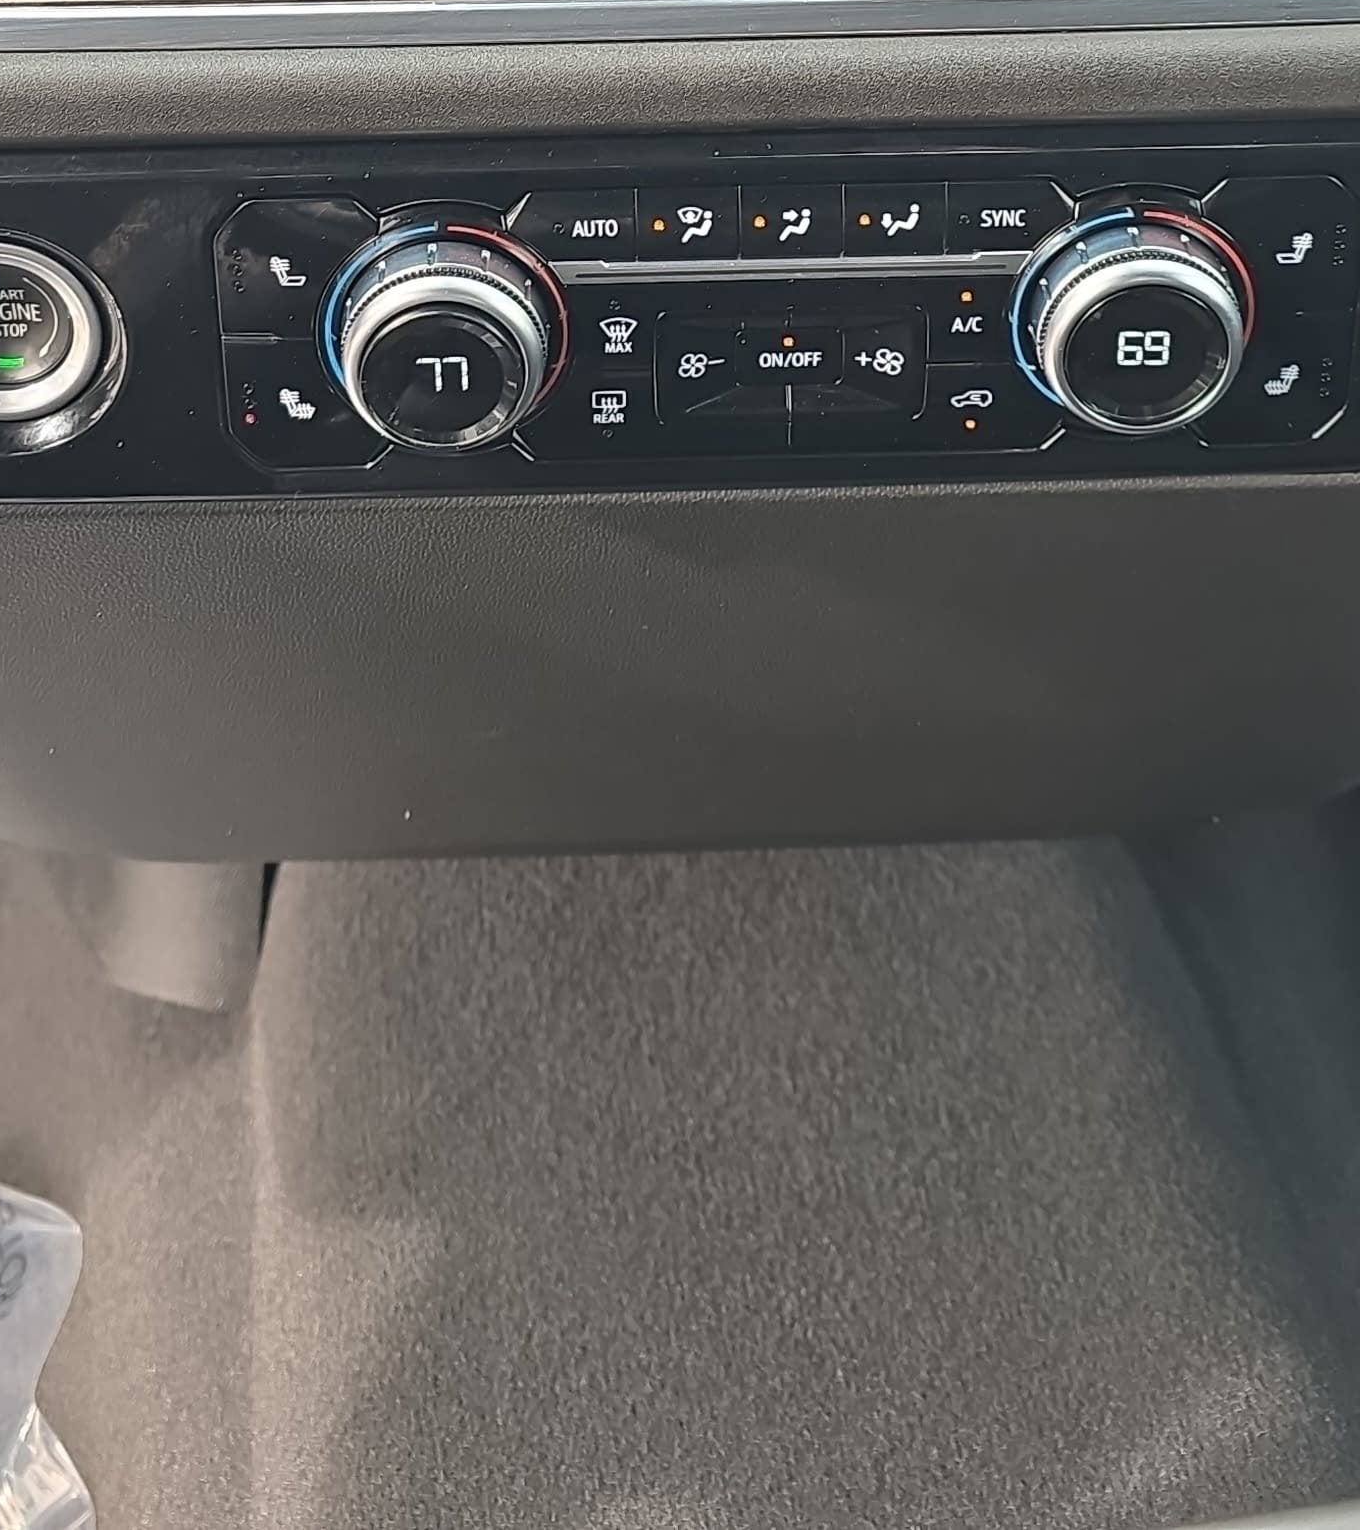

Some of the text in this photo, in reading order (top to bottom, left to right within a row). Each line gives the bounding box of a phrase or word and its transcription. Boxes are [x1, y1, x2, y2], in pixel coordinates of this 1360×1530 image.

[979, 208, 1027, 229] SYNC
[570, 218, 619, 239] AUTO
[951, 316, 984, 335] A/C
[603, 337, 634, 355] MAX
[1115, 329, 1172, 367] 69
[758, 350, 823, 369] ON/OFF
[592, 410, 626, 425] REAR
